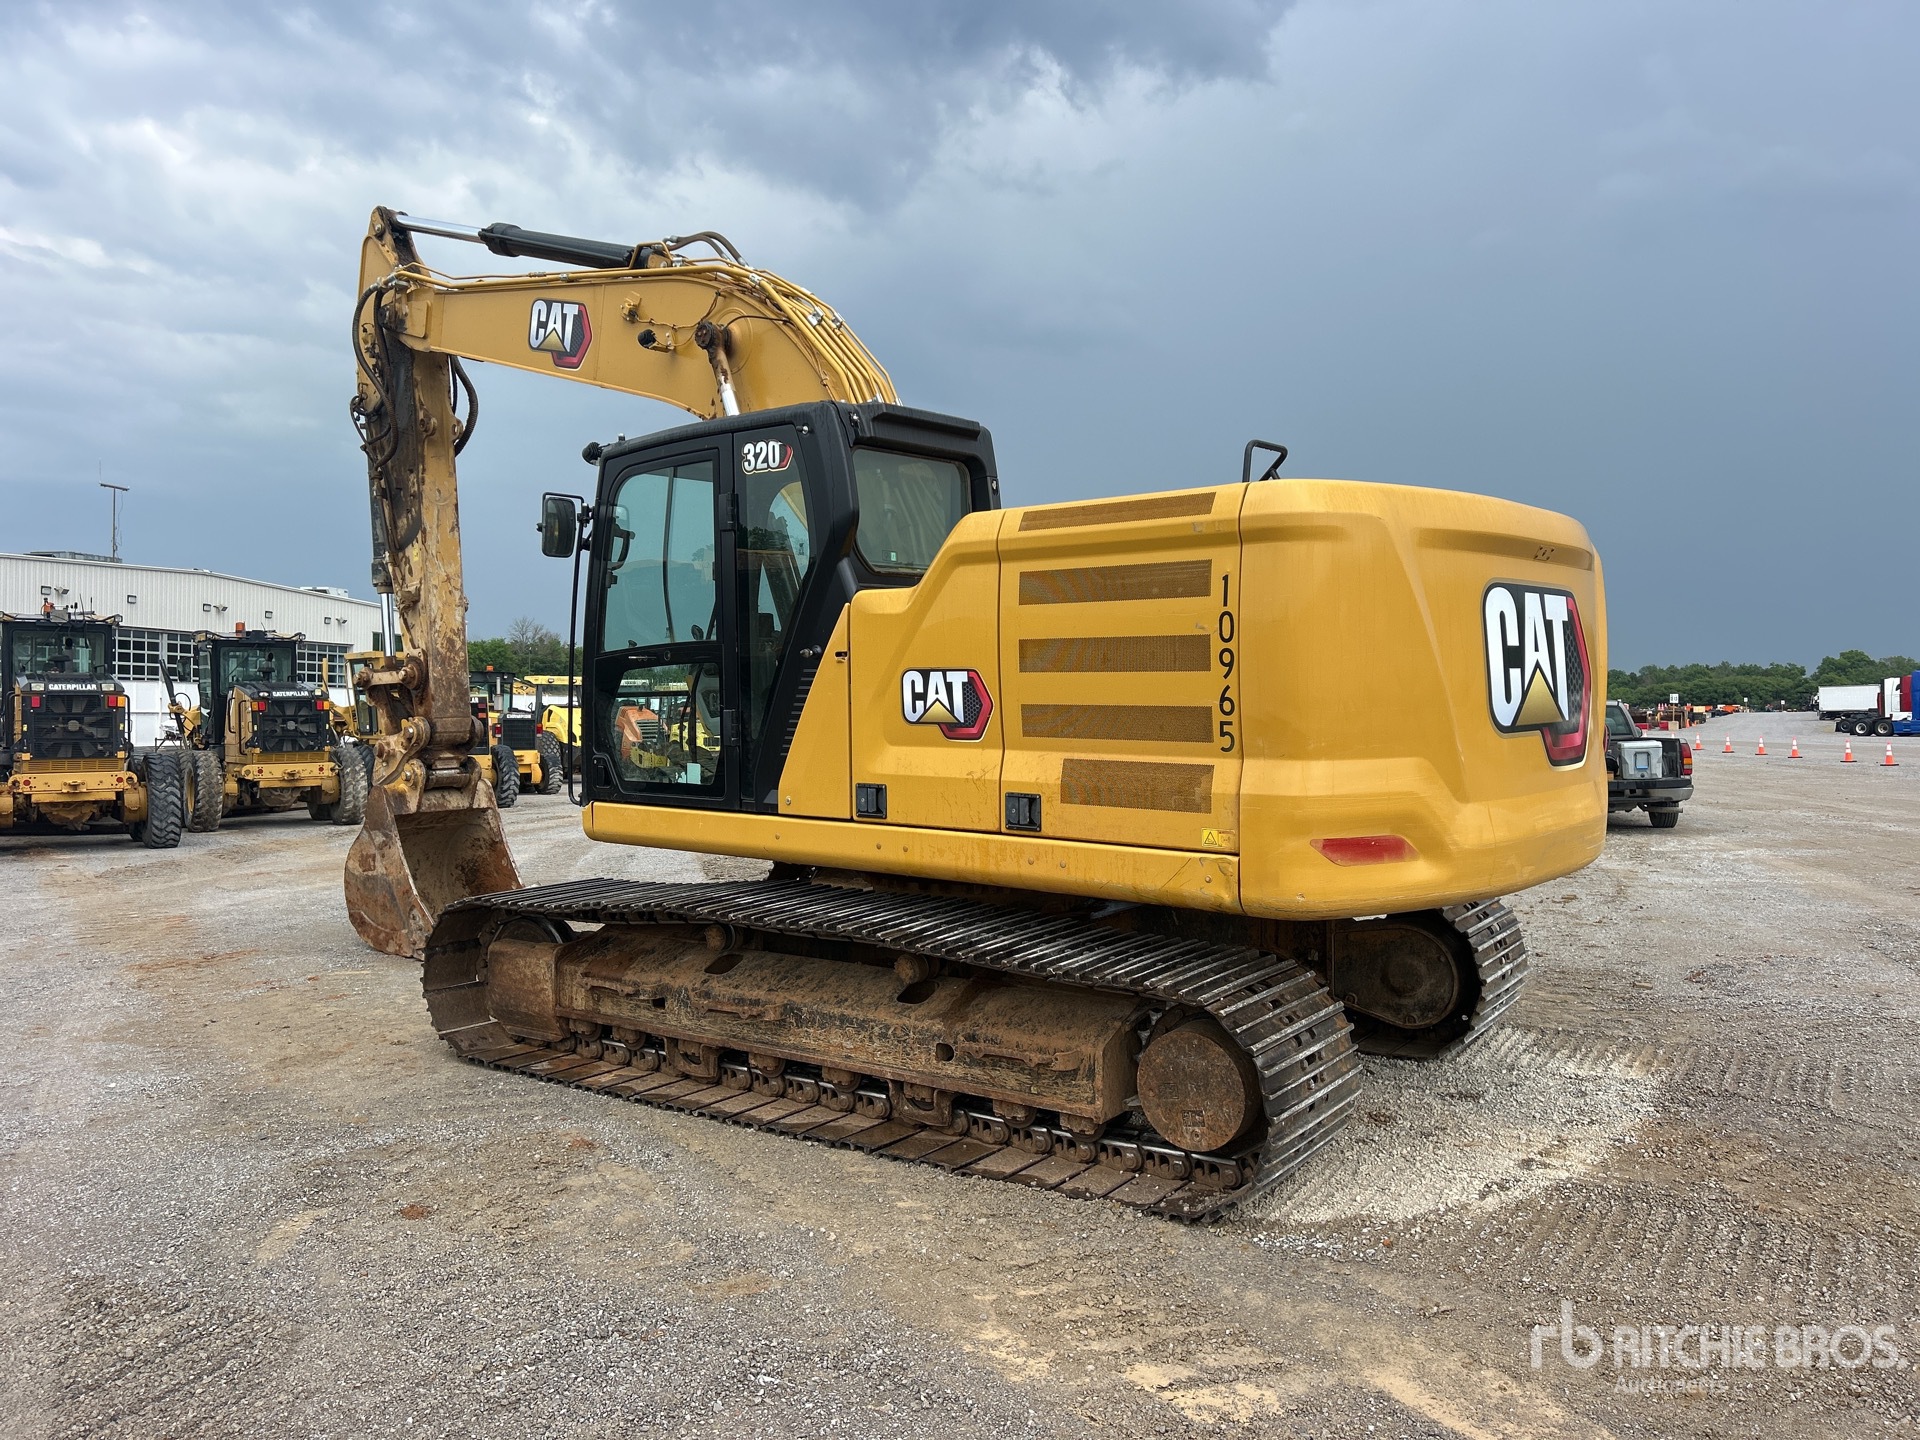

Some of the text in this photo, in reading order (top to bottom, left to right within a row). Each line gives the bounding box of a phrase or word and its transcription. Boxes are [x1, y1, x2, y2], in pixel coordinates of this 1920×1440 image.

[529, 299, 579, 352] CAT
[743, 440, 780, 471] 320
[1218, 574, 1235, 752] 10965
[1485, 586, 1569, 726] CAT
[48, 683, 98, 691] CATERPILLAR
[902, 670, 969, 723] CAT
